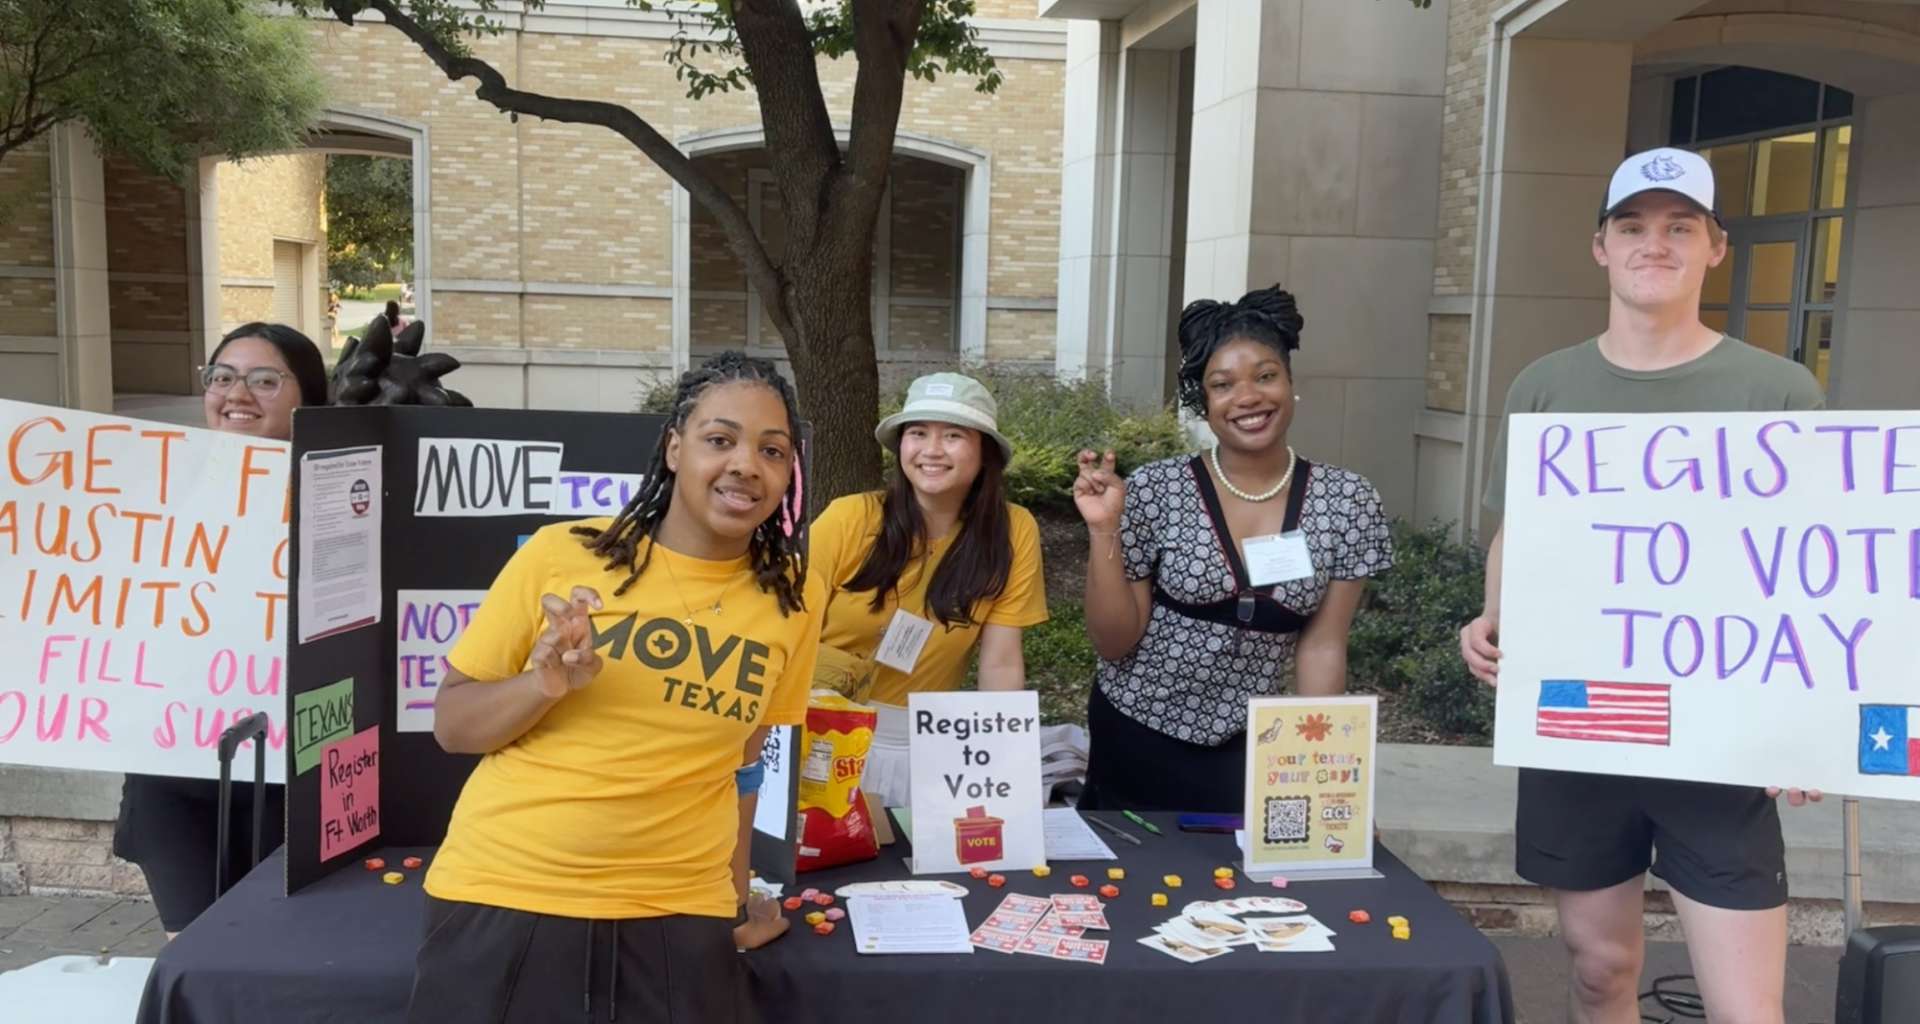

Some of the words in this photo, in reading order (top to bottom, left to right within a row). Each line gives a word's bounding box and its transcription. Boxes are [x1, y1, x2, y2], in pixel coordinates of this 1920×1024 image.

[8, 416, 187, 505] GET
[416, 443, 561, 513] MOVE
[1538, 420, 1920, 499] REGISTE
[0, 501, 229, 574] AUSTIN
[1592, 521, 1689, 585] TO
[0, 569, 216, 637] IMITS
[39, 634, 165, 689] FILL
[208, 648, 282, 696] OU
[588, 610, 770, 697] MOVE
[1601, 608, 1873, 692] TODAY
[0, 691, 113, 743] OUR
[296, 692, 353, 747] TEXANS
[663, 676, 759, 724] TEXAS
[916, 710, 1034, 741] Register
[328, 748, 378, 788] Register
[962, 745, 990, 765] to
[1266, 753, 1306, 769] your
[1267, 771, 1310, 786] your
[1316, 767, 1359, 784] say!
[341, 792, 354, 812] in
[944, 774, 1011, 799] Vote
[347, 805, 377, 837] Worth
[967, 837, 996, 847] VOTE
